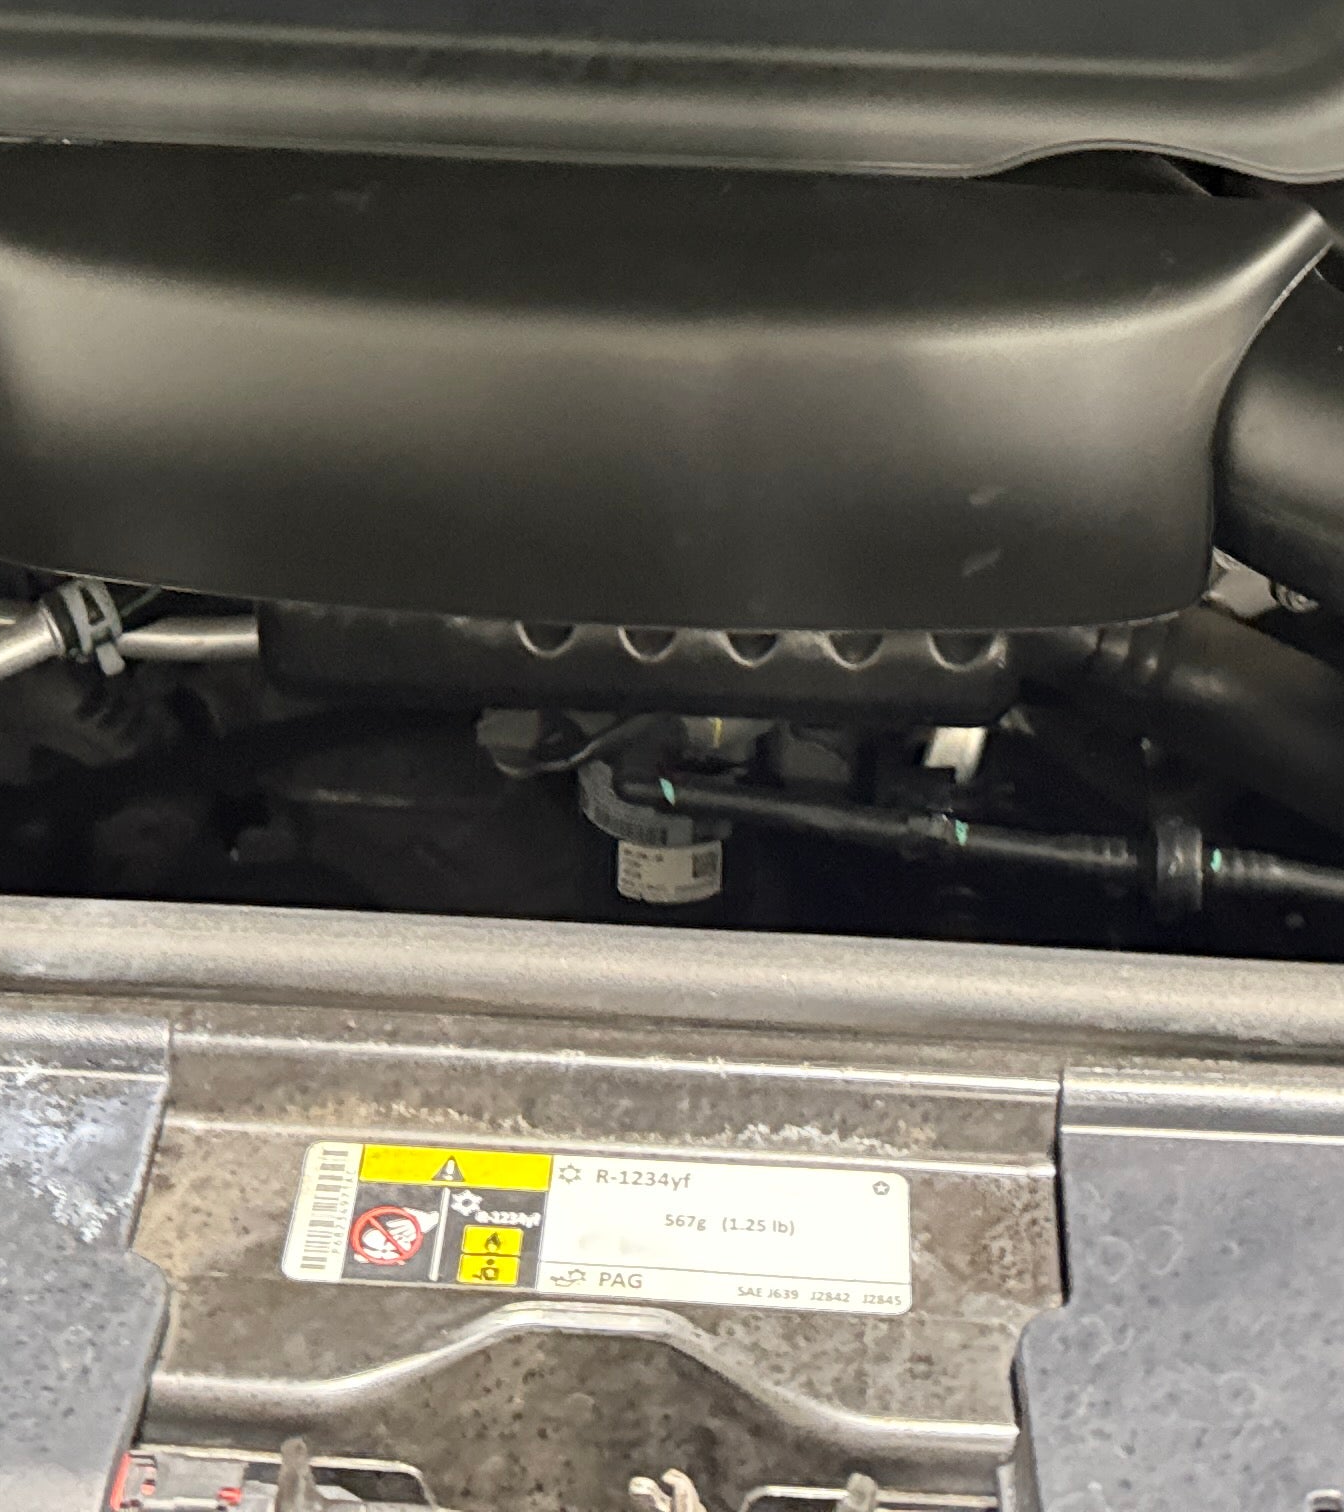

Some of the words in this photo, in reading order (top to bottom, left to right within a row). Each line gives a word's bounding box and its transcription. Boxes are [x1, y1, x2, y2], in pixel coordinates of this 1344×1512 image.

[596, 1169, 692, 1191] R-1234yf
[664, 1213, 707, 1232] 567g
[722, 1217, 767, 1233] (1.25
[772, 1219, 795, 1237] lb)
[599, 1272, 643, 1289] PAG
[737, 1286, 763, 1299] SAE
[767, 1288, 799, 1301] J639
[810, 1291, 850, 1304] J2842
[862, 1294, 902, 1307] J2845
